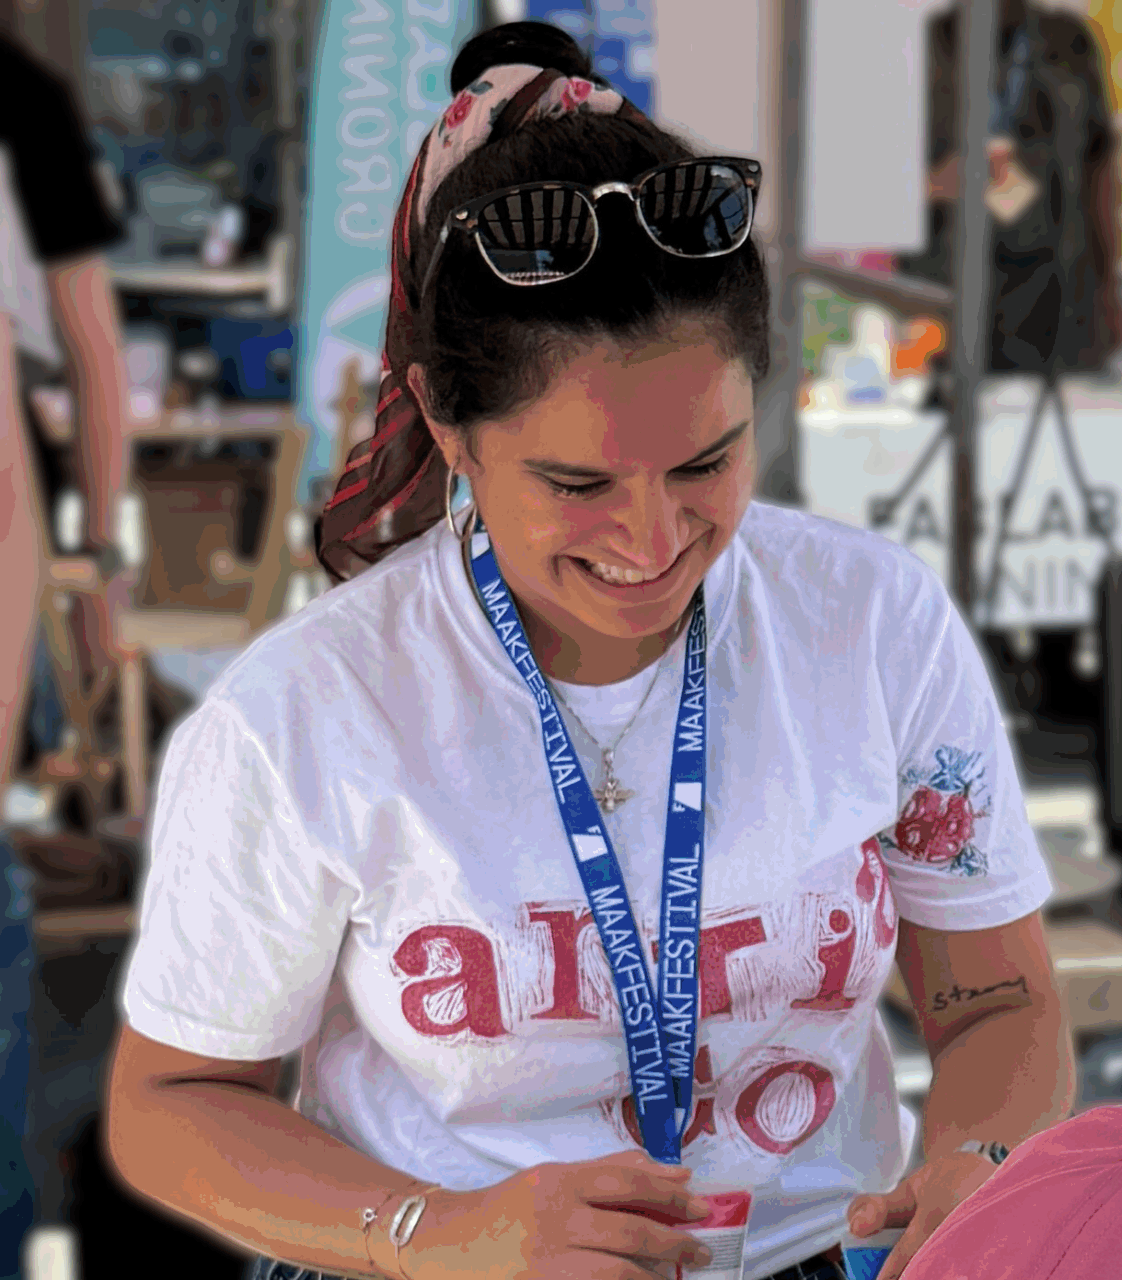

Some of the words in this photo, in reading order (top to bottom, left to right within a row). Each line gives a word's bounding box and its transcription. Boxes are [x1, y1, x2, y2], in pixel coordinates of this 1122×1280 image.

[481, 578, 582, 805] MAAKFESTIVAL
[590, 884, 669, 1116] MAAKFESTIVAL
[660, 842, 701, 1077] MAAKFESTIVAL
